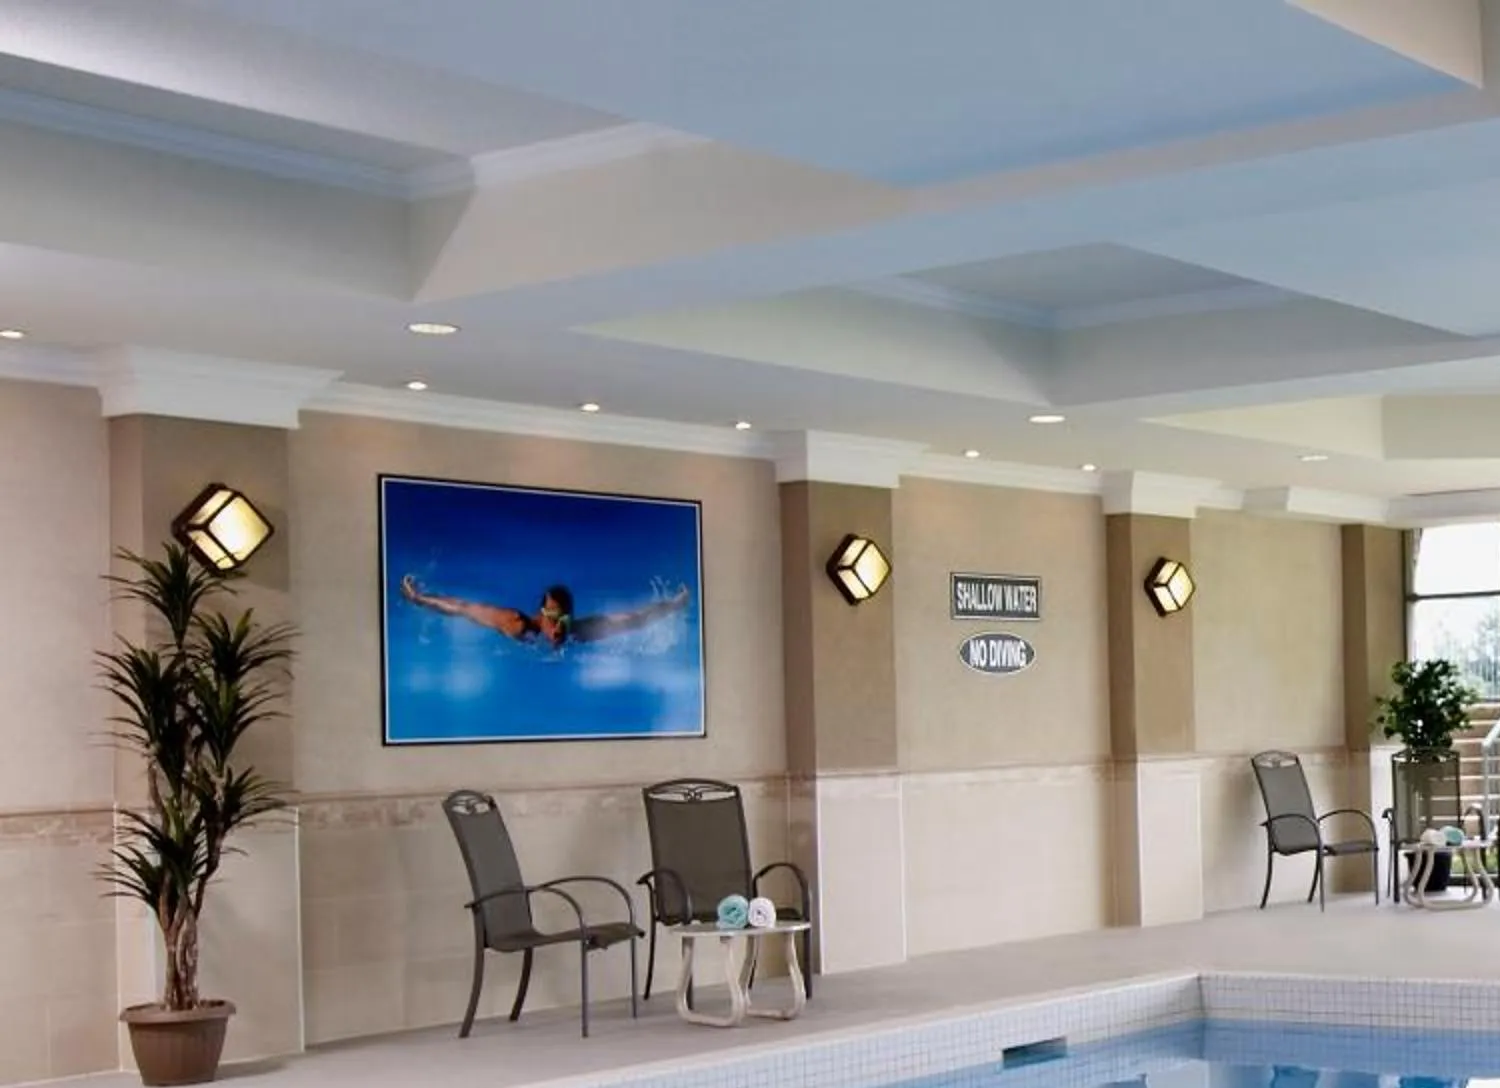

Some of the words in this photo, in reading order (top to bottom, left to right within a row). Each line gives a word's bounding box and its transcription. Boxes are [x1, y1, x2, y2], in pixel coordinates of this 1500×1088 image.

[957, 582, 1003, 611] SHALLOW
[1004, 584, 1036, 612] WATER
[969, 640, 987, 667] NO
[989, 640, 1026, 667] DIVING
